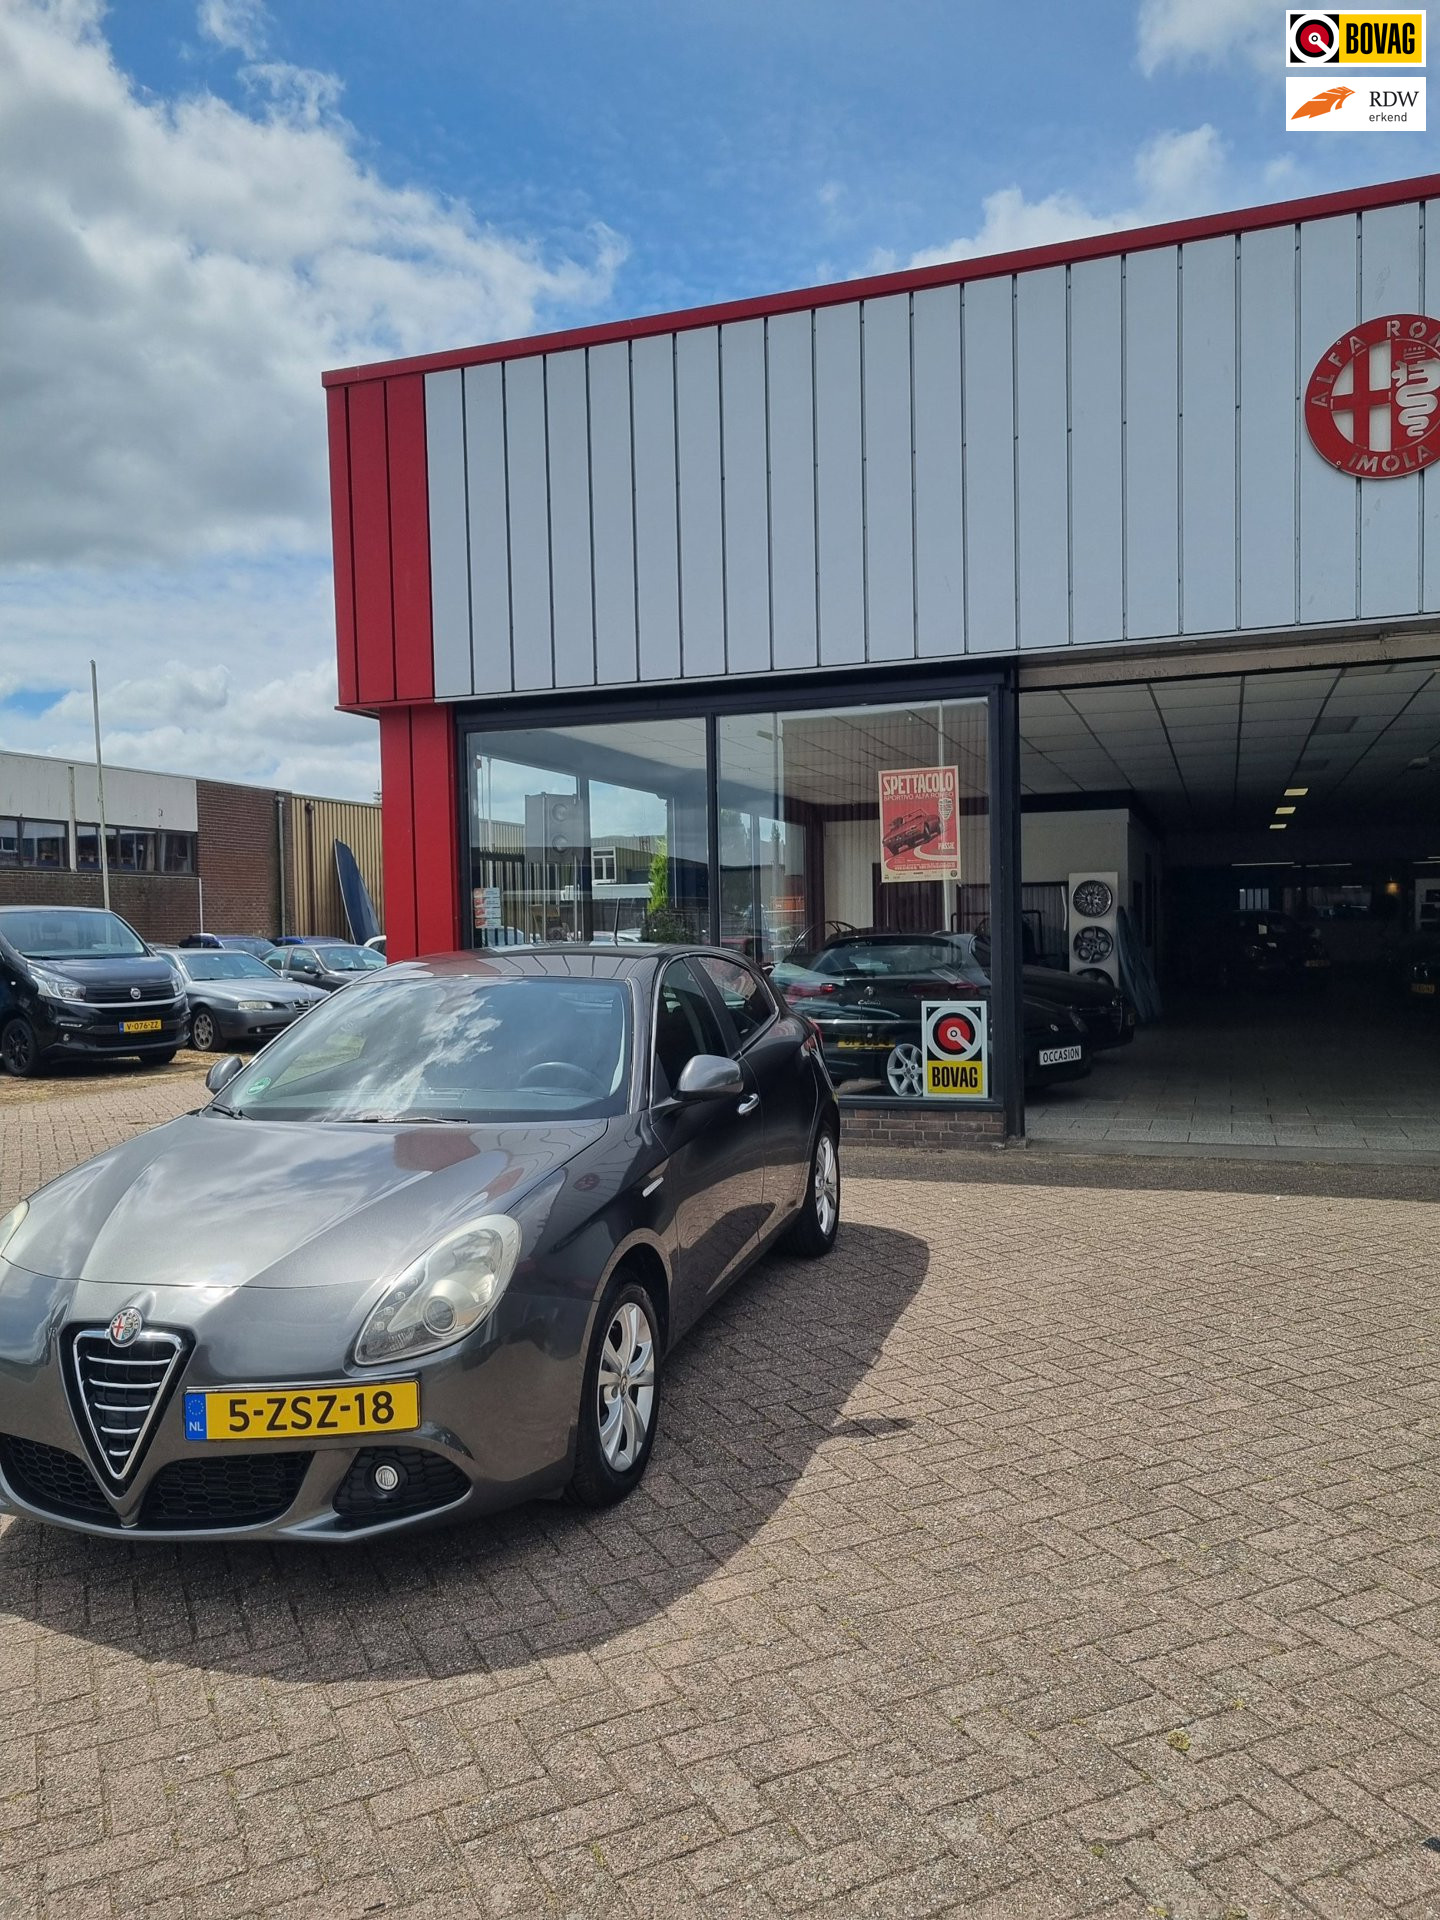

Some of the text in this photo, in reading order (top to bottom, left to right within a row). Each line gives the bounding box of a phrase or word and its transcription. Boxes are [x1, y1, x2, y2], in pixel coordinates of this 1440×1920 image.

[1311, 335, 1367, 408] ALFA
[1347, 445, 1435, 473] IMOLA
[882, 771, 954, 796] SPETTACOLO
[1042, 1047, 1080, 1063] OCCASION
[931, 1066, 978, 1088] BOVAG
[228, 1391, 395, 1432] 5-ZSZ-18
[189, 1421, 204, 1431] NL
